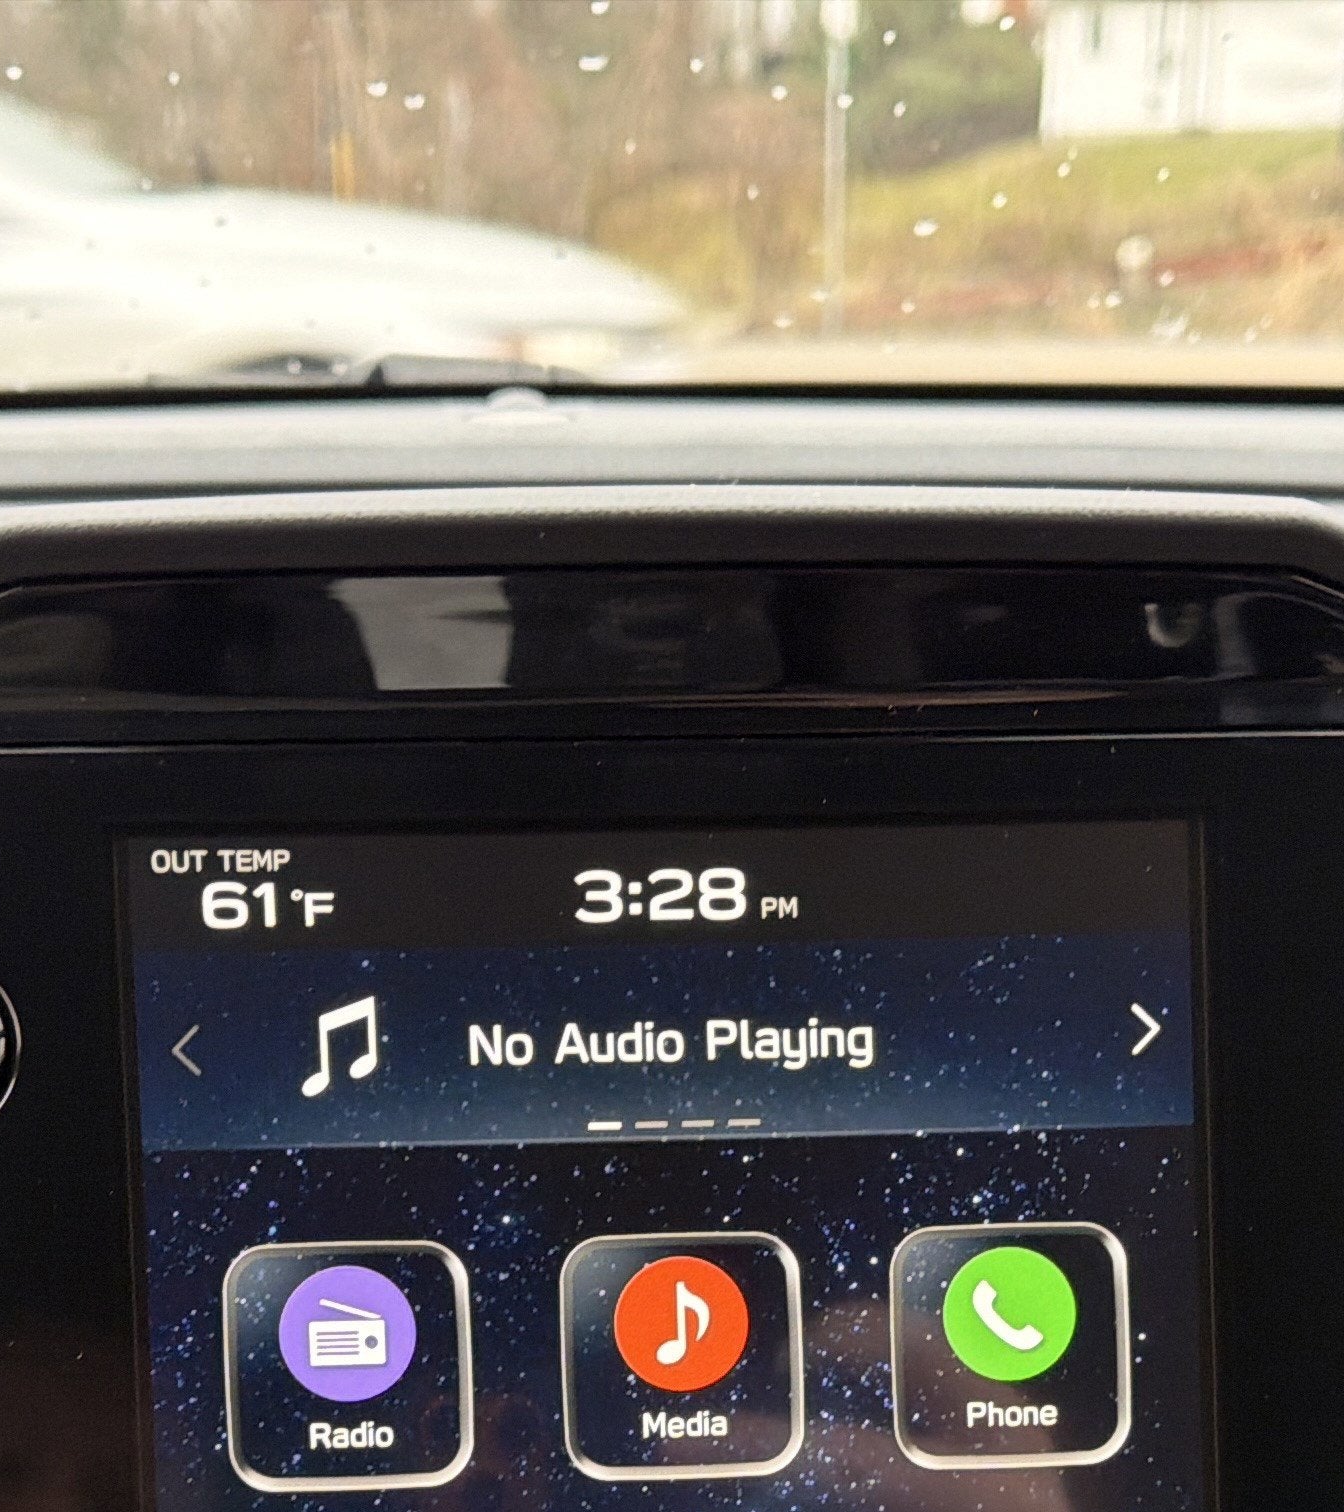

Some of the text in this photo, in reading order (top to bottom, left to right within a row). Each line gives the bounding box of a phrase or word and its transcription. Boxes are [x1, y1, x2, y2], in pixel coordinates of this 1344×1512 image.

[150, 848, 291, 874] OUT TEMP
[574, 867, 798, 924] 3:28 PM
[469, 1017, 874, 1070] No Audio Playing
[642, 1409, 729, 1439] Media
[966, 1400, 1059, 1429] Phone
[309, 1420, 395, 1450] Radio
